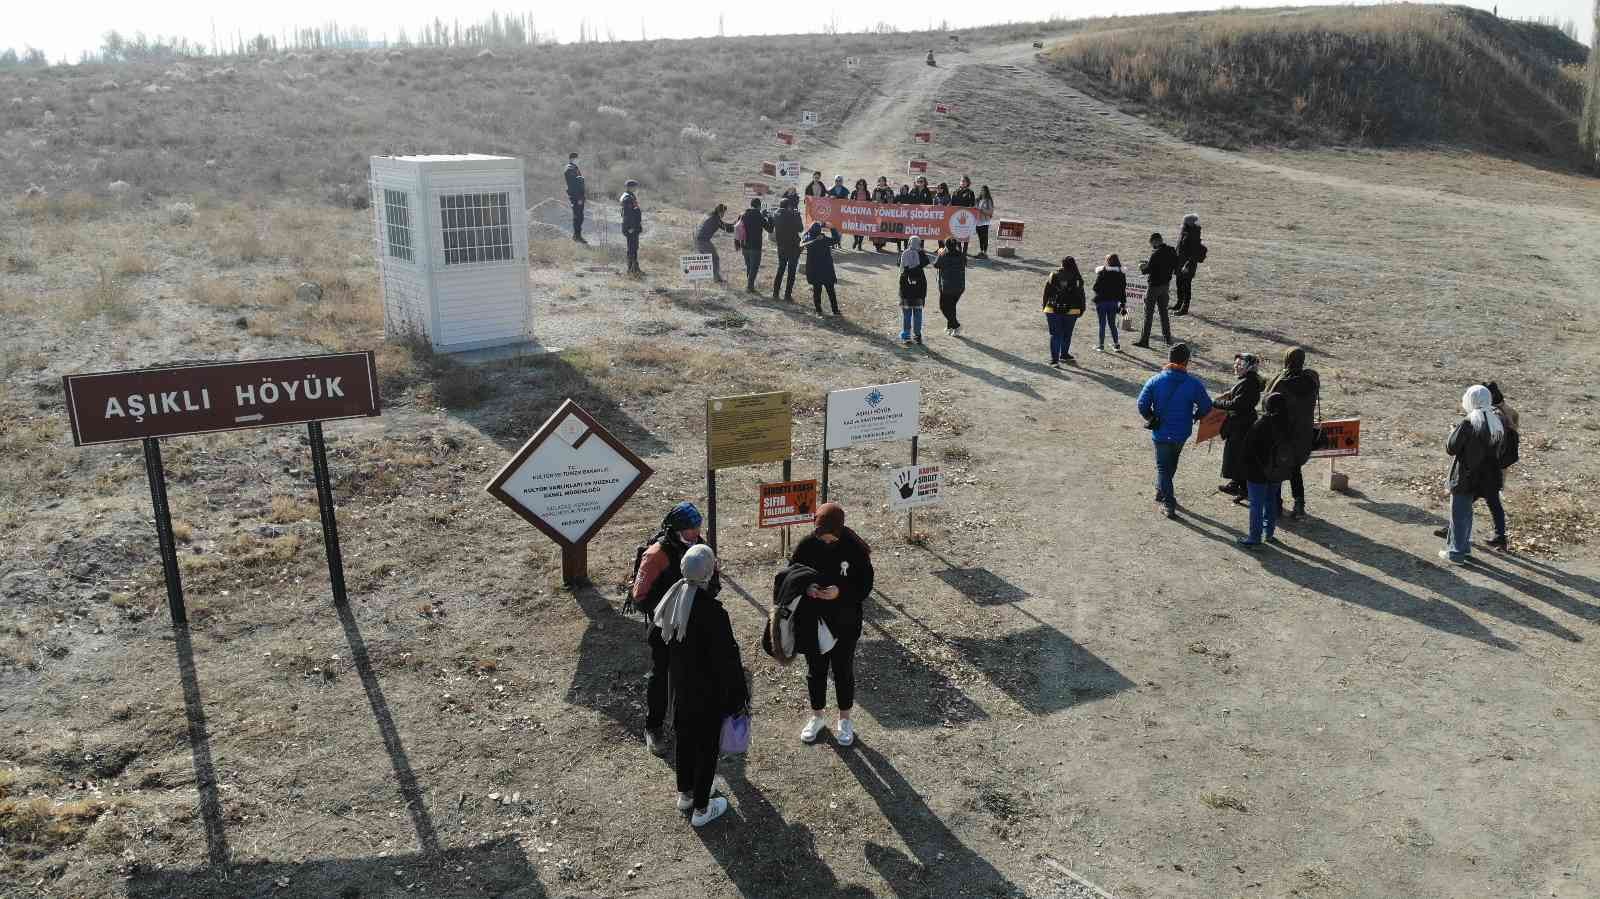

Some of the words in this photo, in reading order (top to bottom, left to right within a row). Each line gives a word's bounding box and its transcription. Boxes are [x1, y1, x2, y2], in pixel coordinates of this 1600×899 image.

[840, 205, 872, 216] KADINA
[873, 206, 908, 219] YÖNELİK
[910, 207, 945, 221] ŞİDDETE
[879, 221, 904, 234] DUR
[105, 388, 211, 423] AŞIKLI
[235, 374, 346, 407] HÖYÜK
[764, 495, 786, 509] SIFIR
